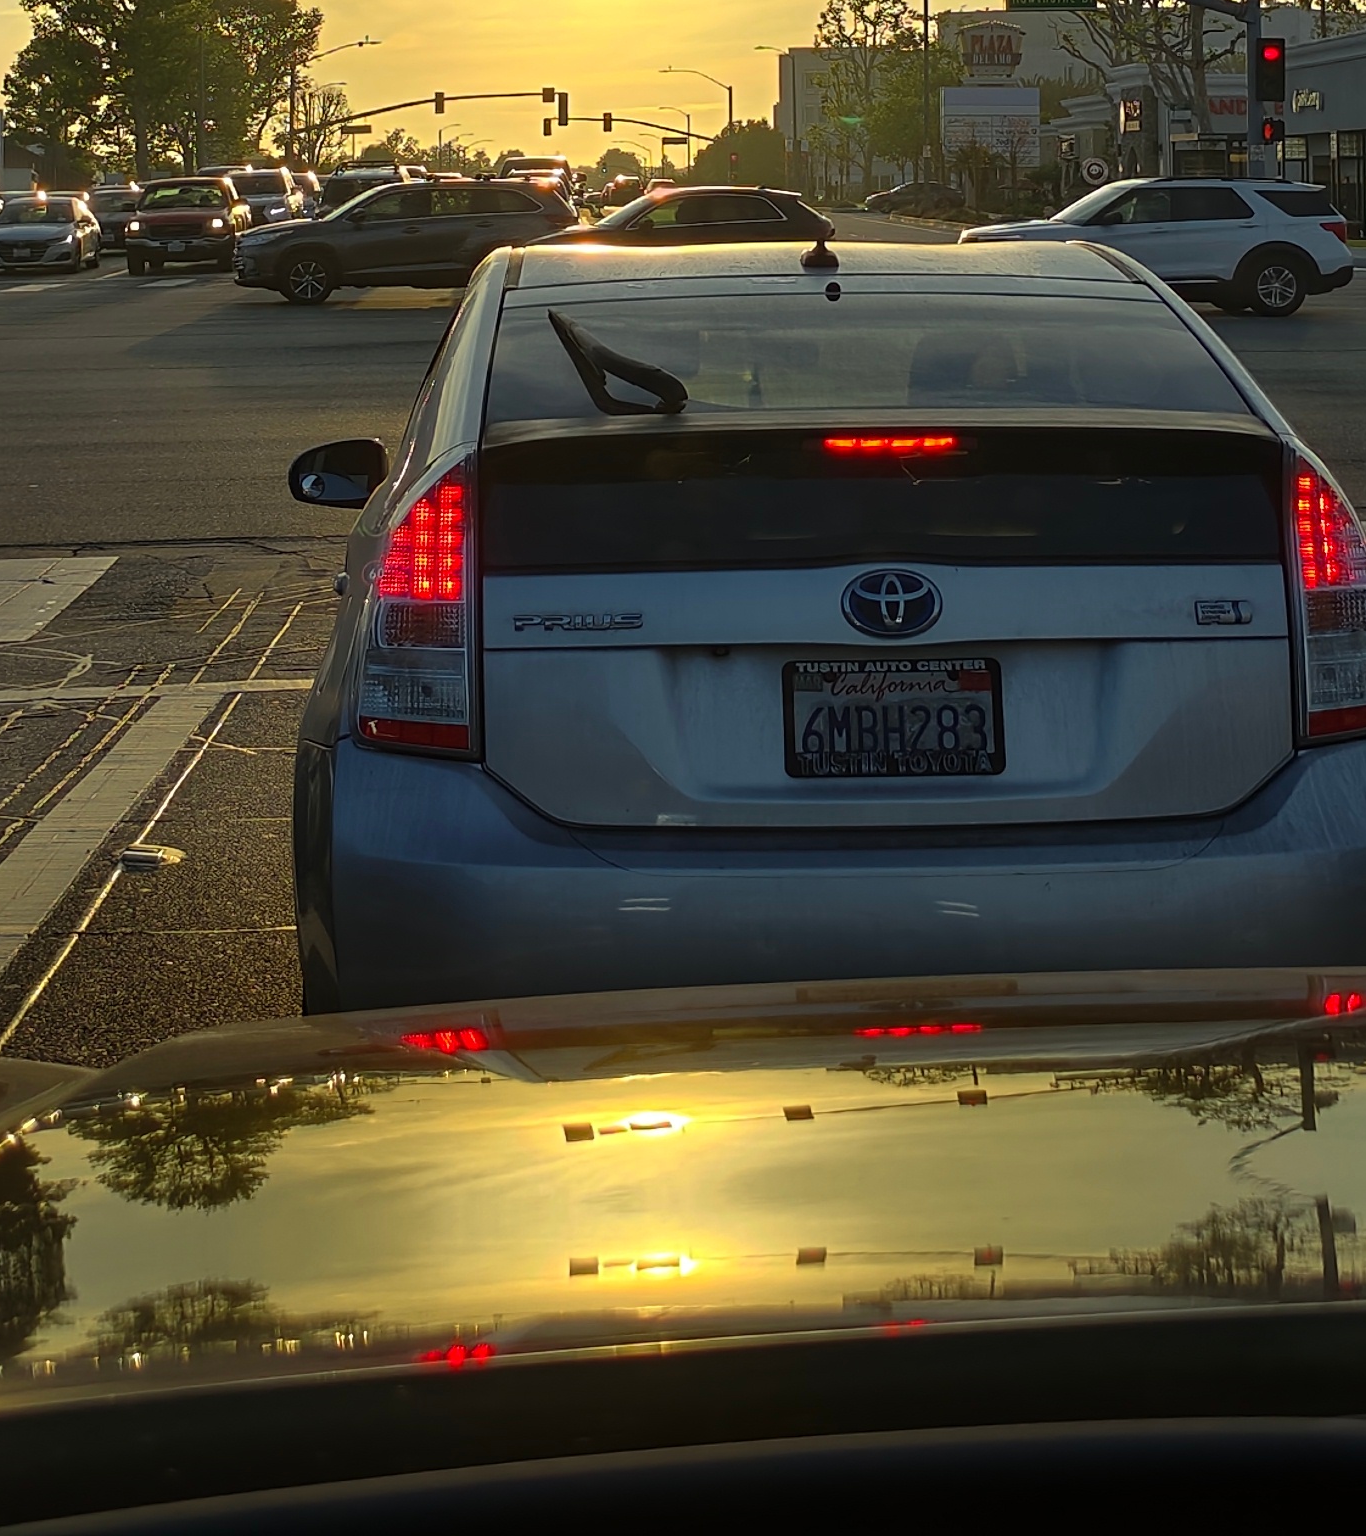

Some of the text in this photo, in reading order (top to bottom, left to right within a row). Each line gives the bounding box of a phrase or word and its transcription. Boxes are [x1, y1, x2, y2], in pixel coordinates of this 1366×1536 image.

[971, 35, 1013, 54] PLAZA
[513, 614, 644, 632] PRIUS
[795, 659, 986, 672] TUSTIN AUTO CENTER
[831, 672, 958, 702] California
[802, 704, 988, 754] 6MBH283
[796, 750, 993, 775] TUSTIN TOYOTA
